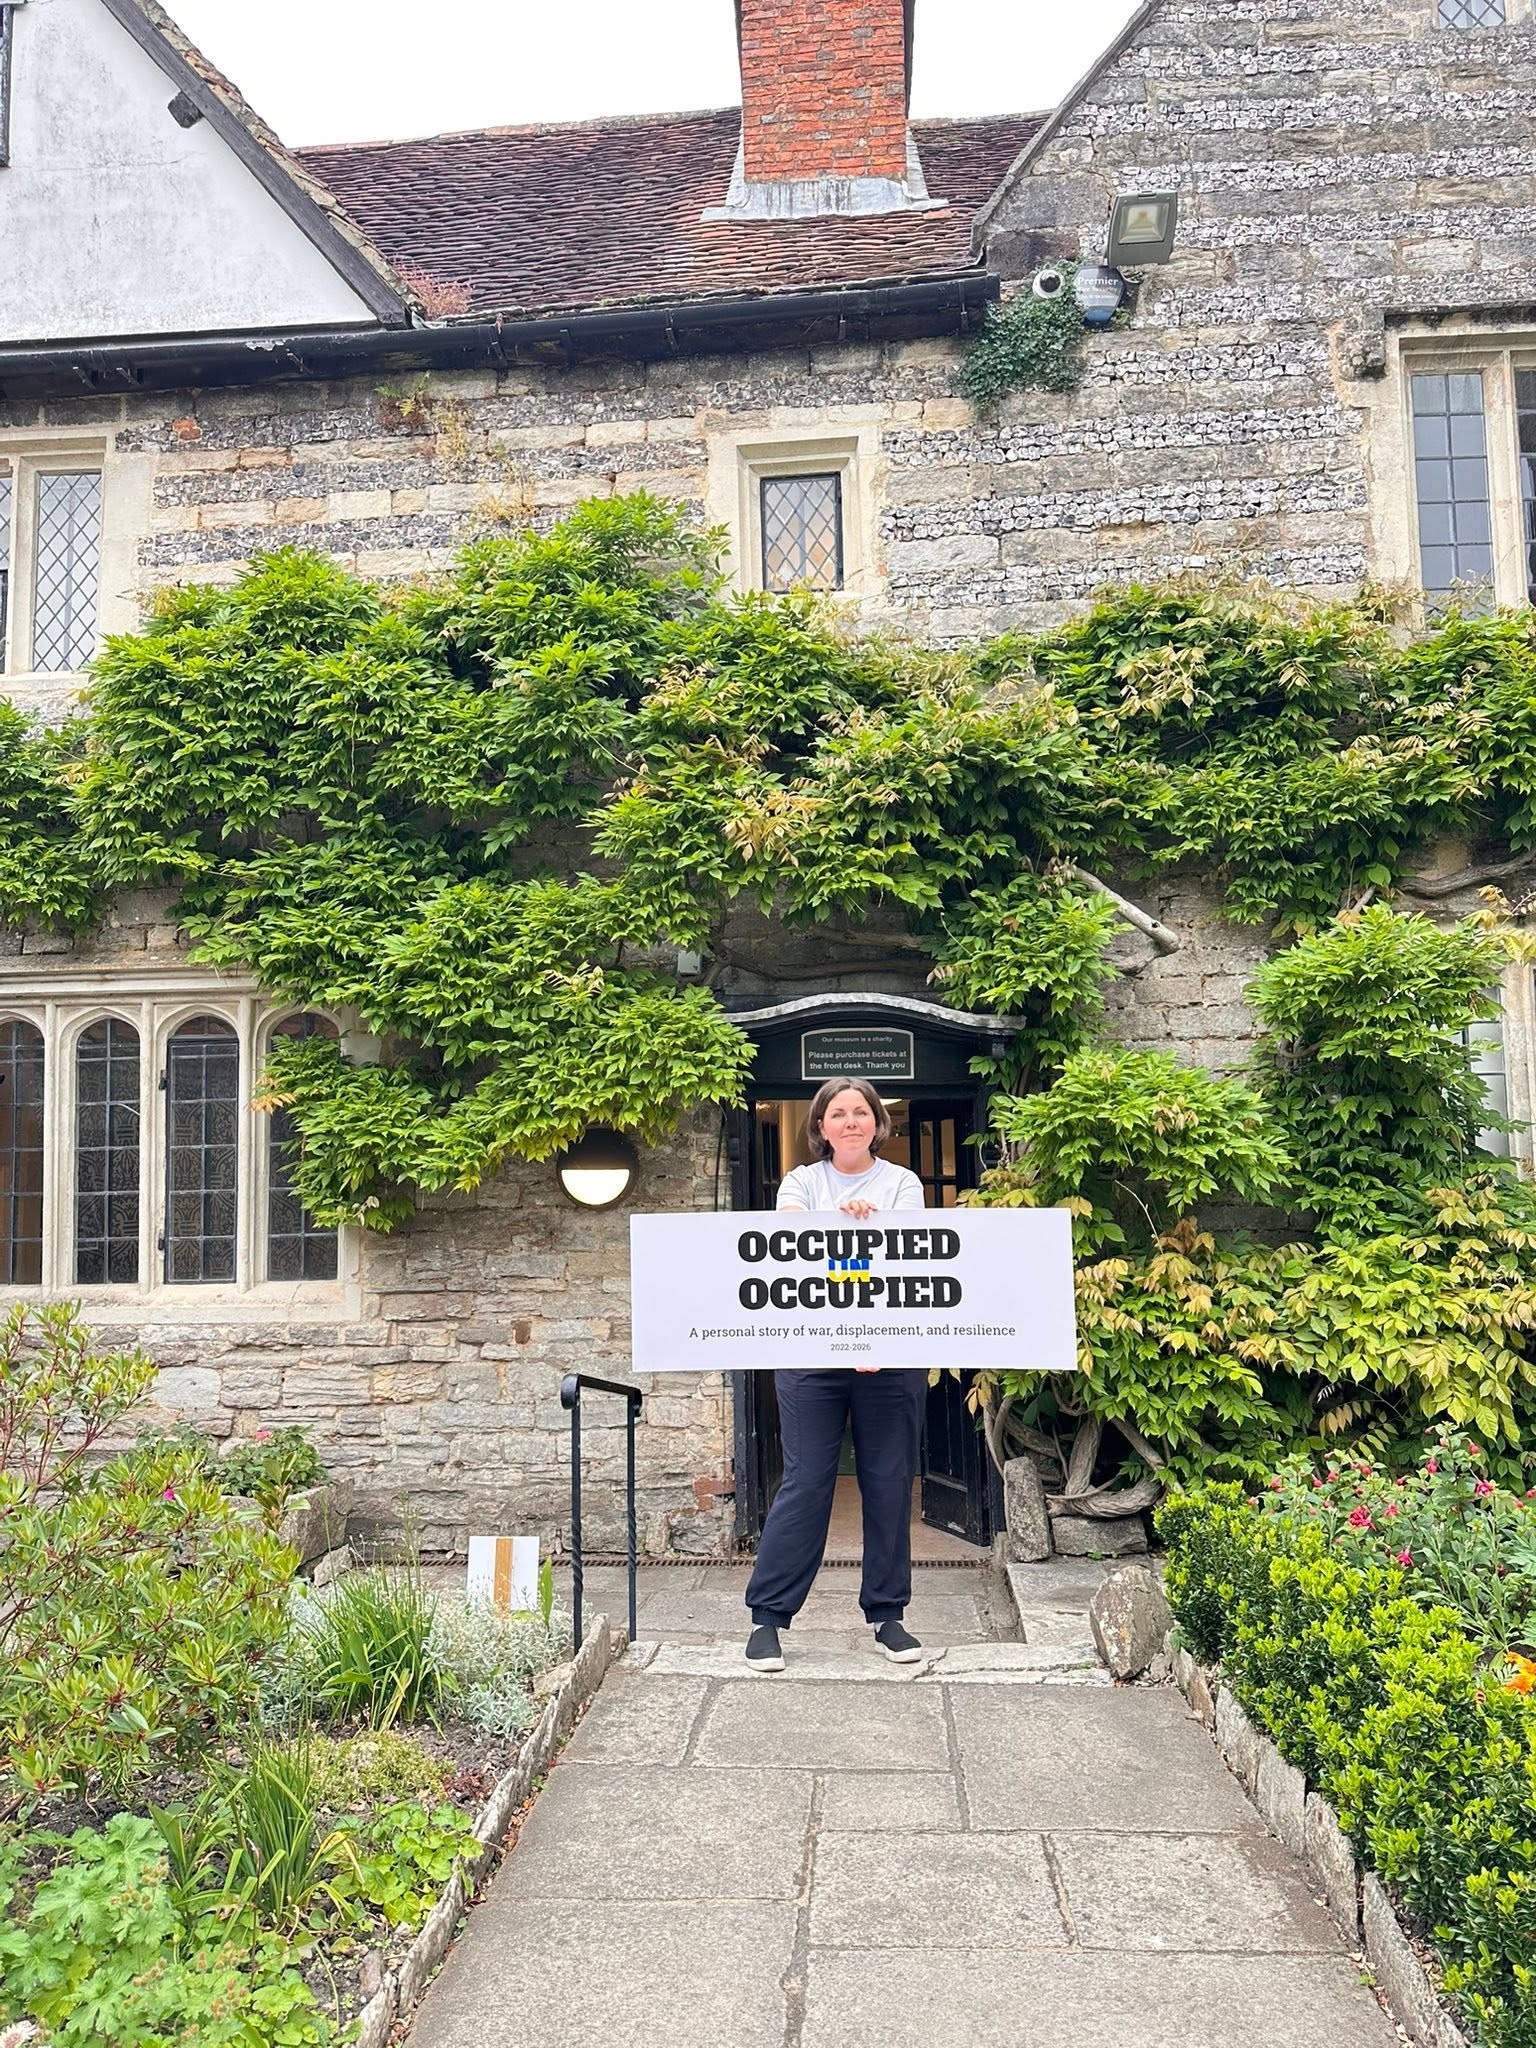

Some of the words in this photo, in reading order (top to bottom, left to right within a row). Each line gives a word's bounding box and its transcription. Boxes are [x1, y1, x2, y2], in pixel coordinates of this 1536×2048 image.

[1078, 276, 1119, 286] Premier
[808, 1051, 834, 1059] Please
[835, 1051, 871, 1060] purchase
[809, 1062, 823, 1070] the
[843, 1061, 864, 1069] desk.
[866, 1061, 890, 1069] Thank
[890, 1062, 906, 1070] you
[738, 1228, 961, 1263] OCCUPIED
[828, 1258, 871, 1283] UN
[738, 1276, 963, 1310] OCCUPIED
[689, 1327, 699, 1338] A
[702, 1325, 756, 1340] personal
[758, 1326, 790, 1339] story
[792, 1325, 806, 1337] of
[808, 1326, 834, 1338] war,
[836, 1324, 924, 1338] displacement,
[926, 1324, 950, 1336] and
[953, 1324, 1017, 1337] resilience
[830, 1343, 872, 1351] 2022-2026
